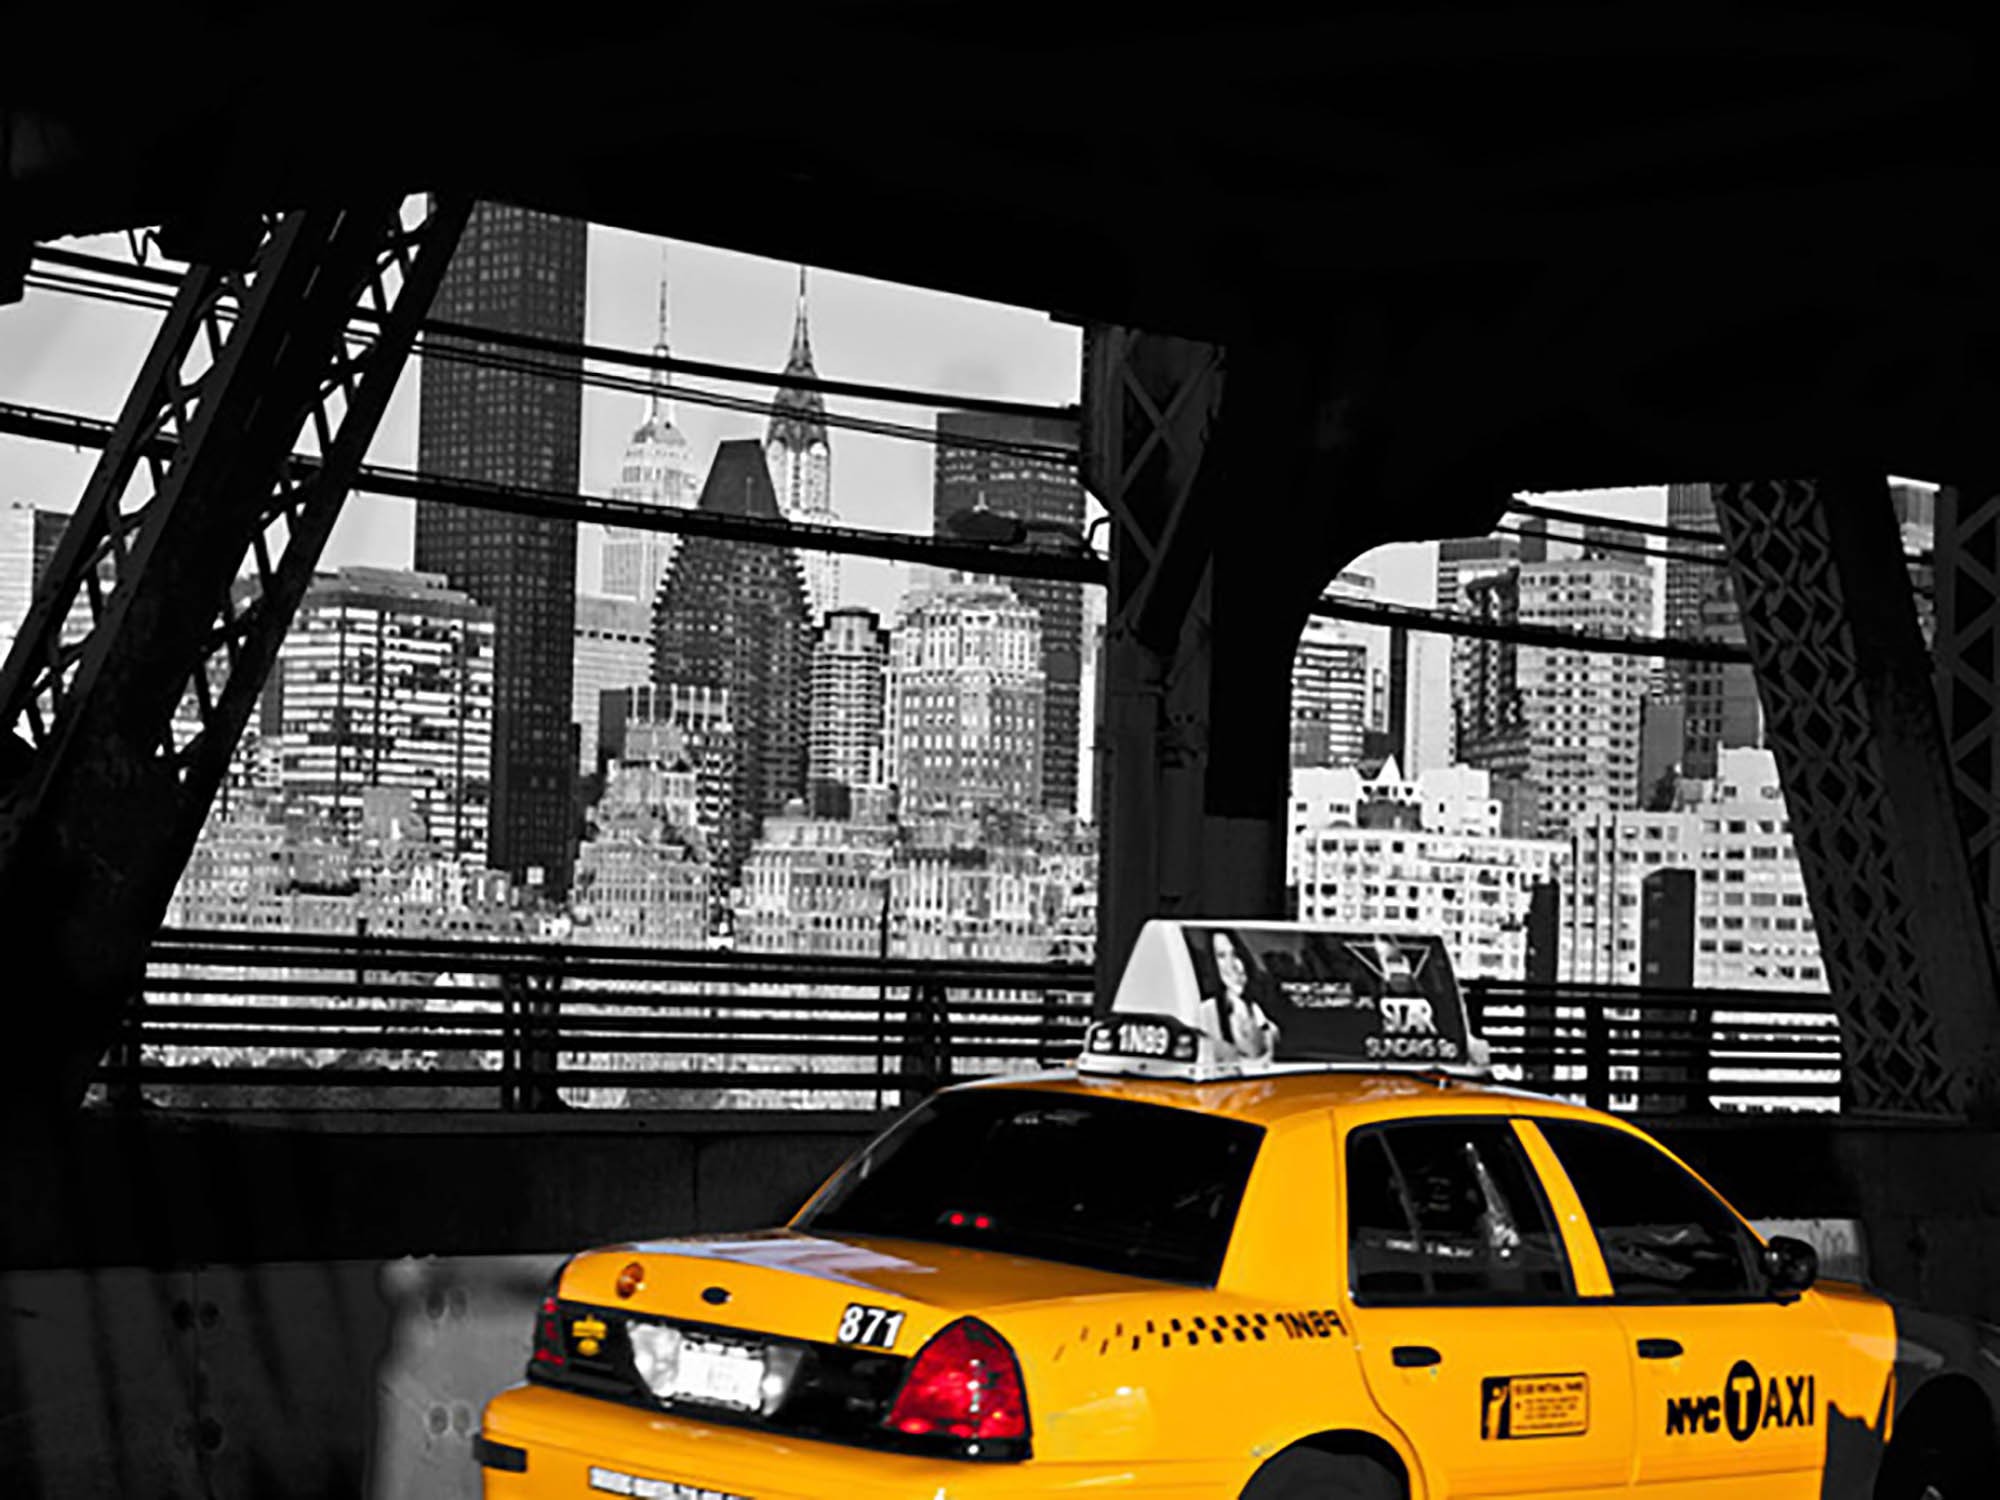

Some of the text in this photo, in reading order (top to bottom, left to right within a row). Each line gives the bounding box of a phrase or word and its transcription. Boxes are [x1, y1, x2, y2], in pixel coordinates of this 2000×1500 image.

[1118, 1024, 1169, 1055] 1N89
[838, 1305, 904, 1348] 871
[1275, 1309, 1348, 1340] 1N89
[1666, 1374, 1815, 1436] NYC TAXI
